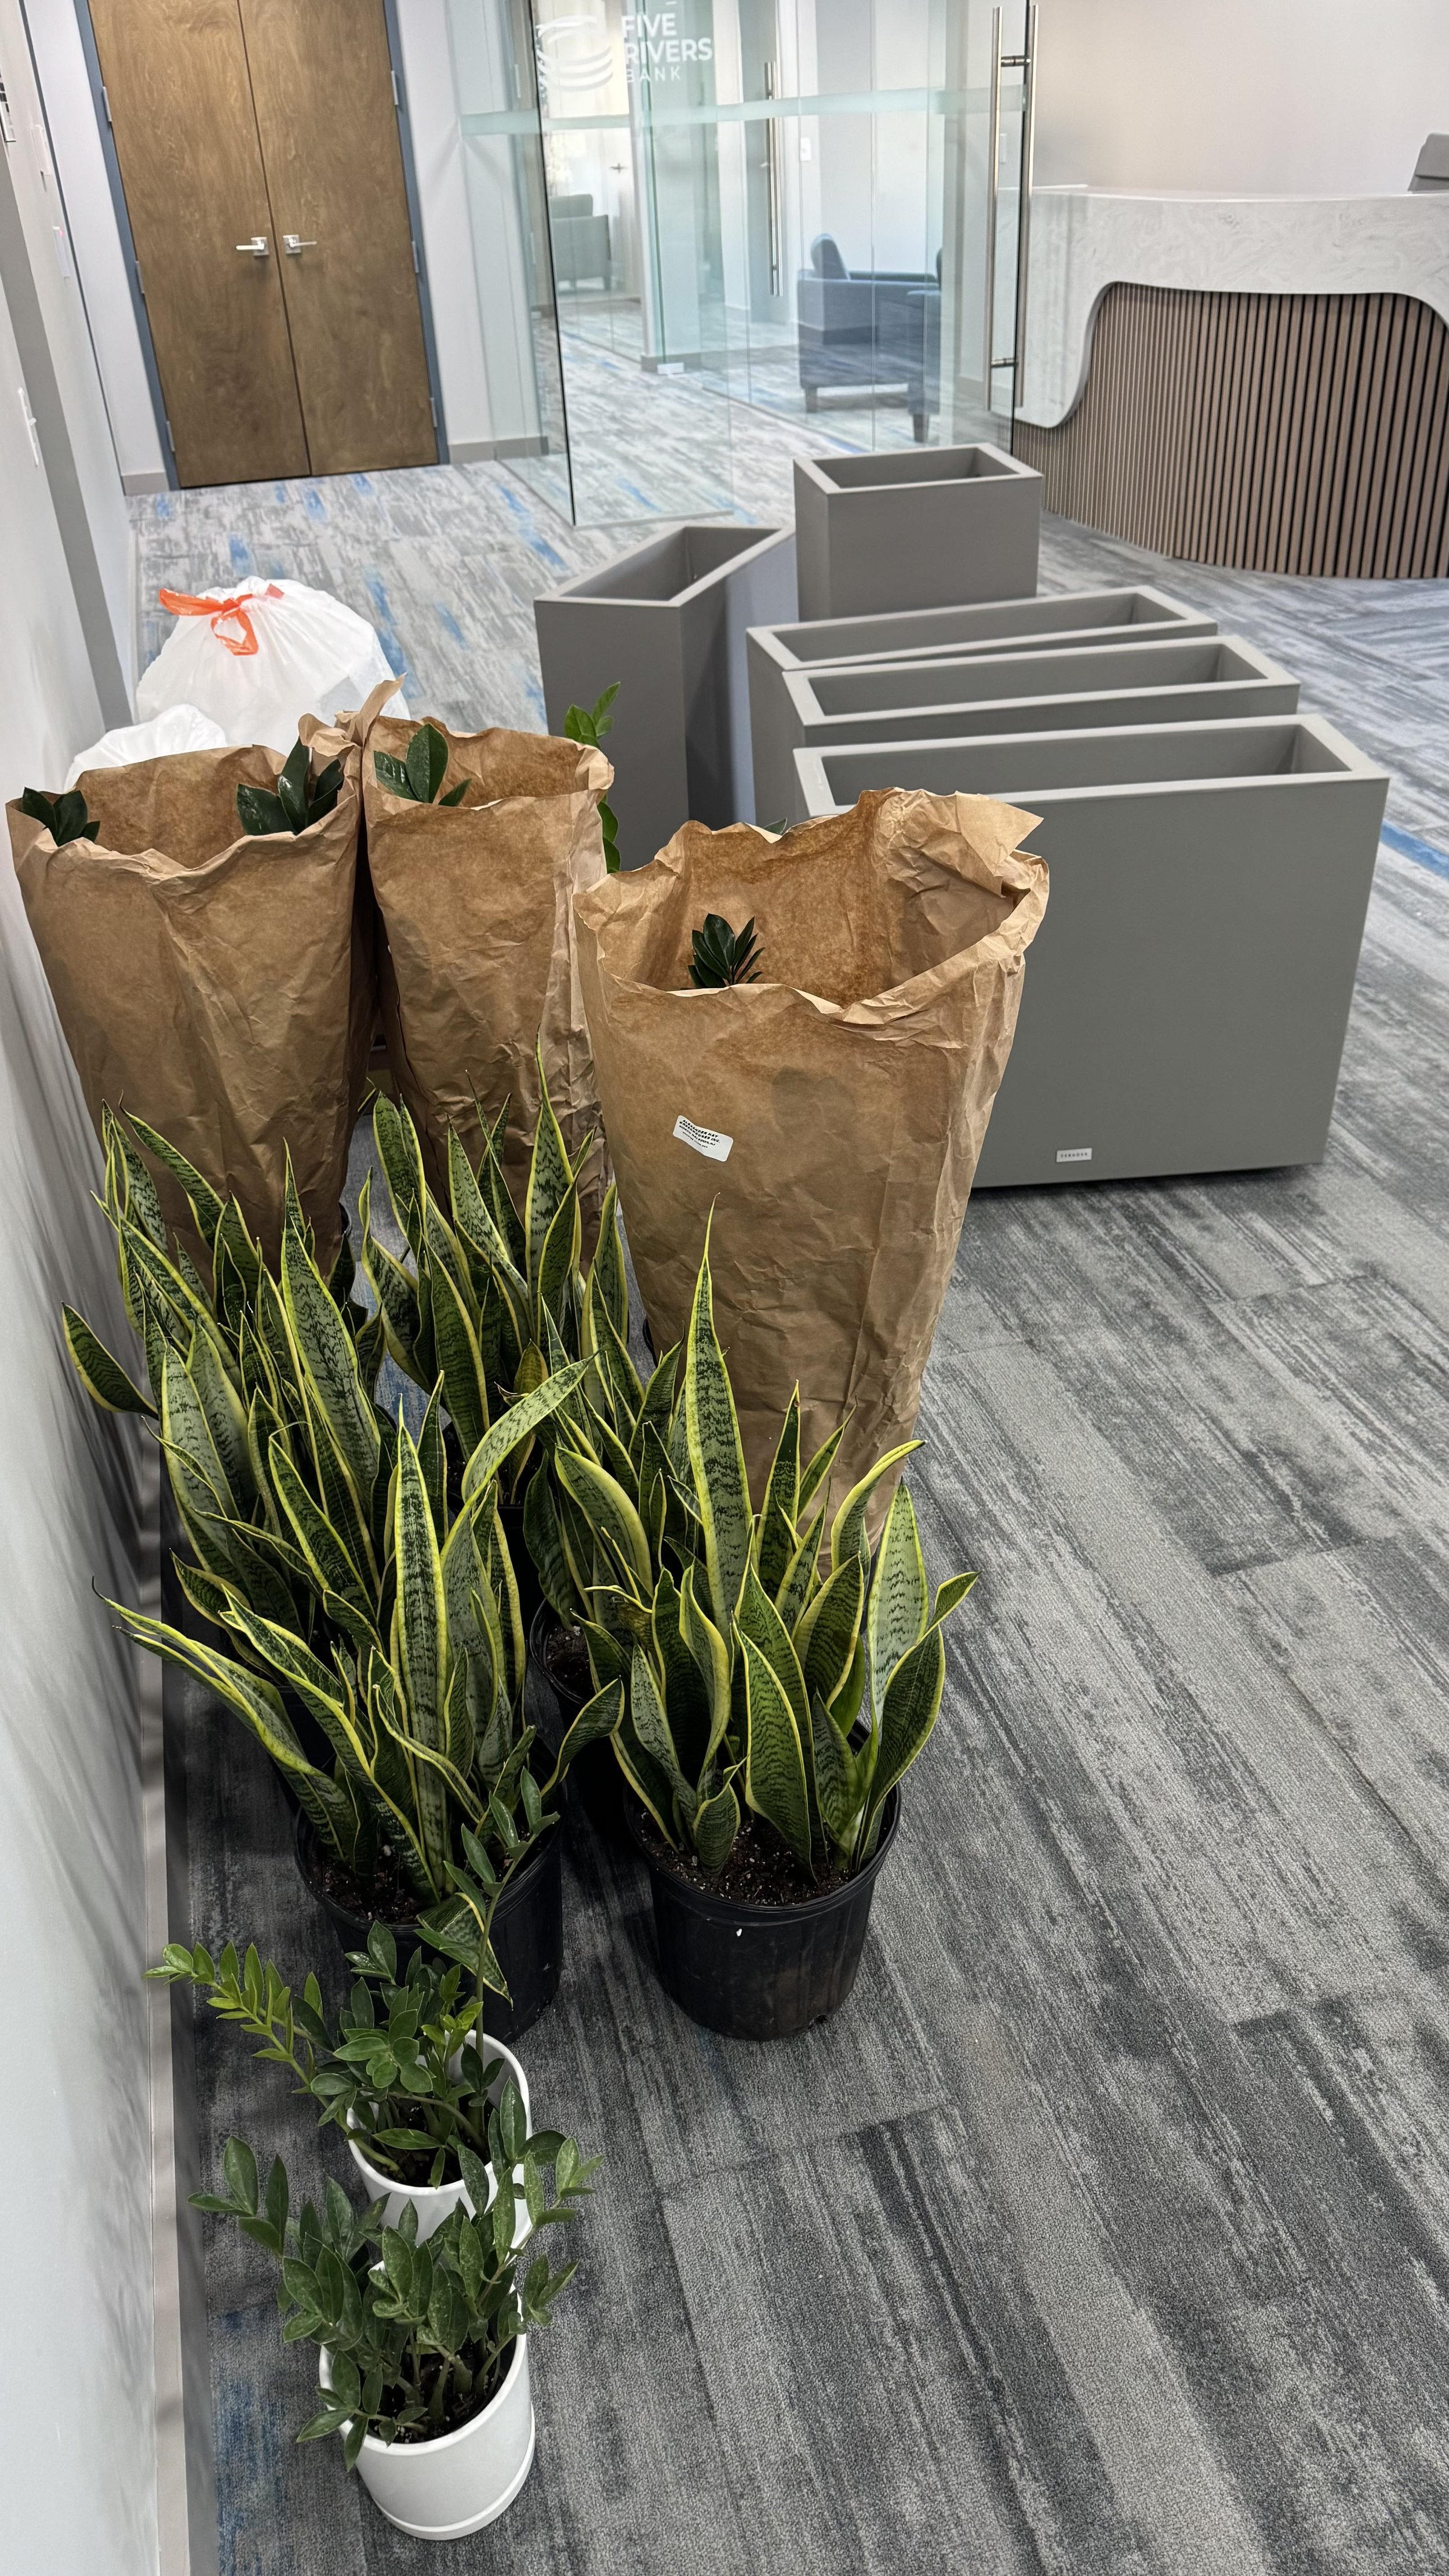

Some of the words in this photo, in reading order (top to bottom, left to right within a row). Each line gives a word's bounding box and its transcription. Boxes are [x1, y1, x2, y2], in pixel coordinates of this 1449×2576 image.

[621, 13, 677, 38] FIVE
[624, 38, 713, 64] RIVERS
[627, 66, 680, 82] BANK
